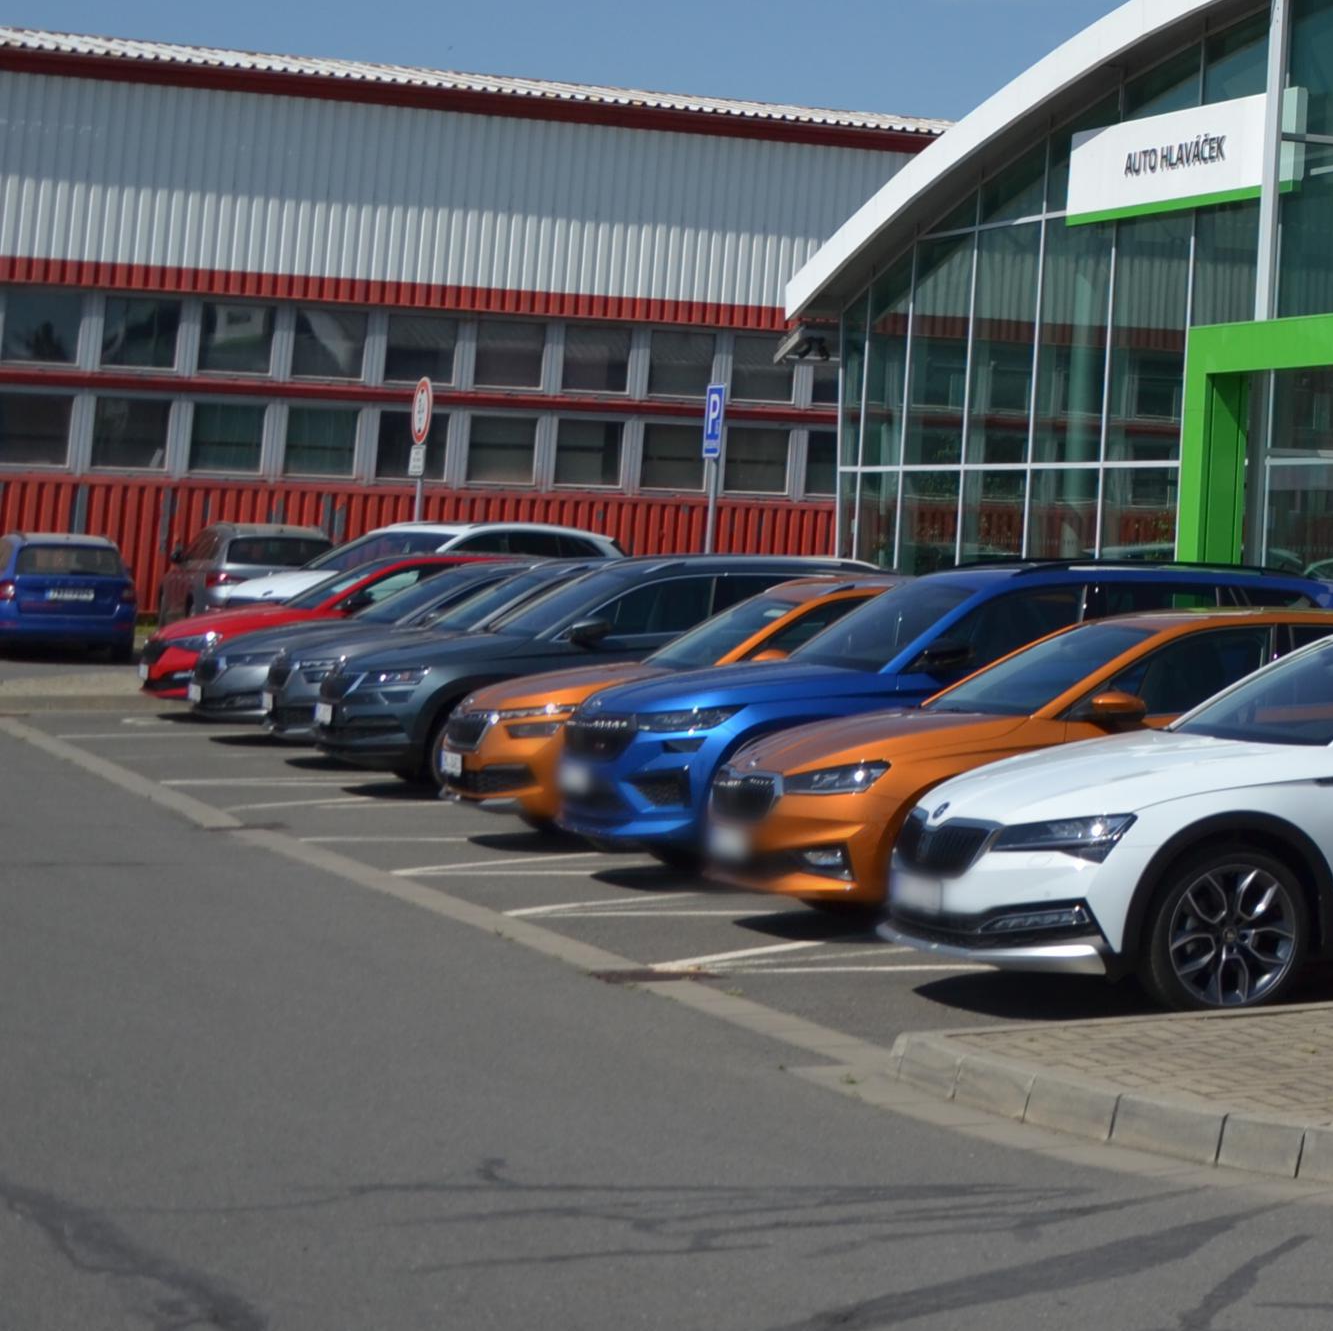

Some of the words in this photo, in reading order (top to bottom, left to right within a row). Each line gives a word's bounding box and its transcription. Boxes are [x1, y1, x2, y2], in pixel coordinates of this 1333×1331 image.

[1124, 148, 1158, 177] AUTO
[1160, 132, 1226, 171] HLAVÁČEK
[707, 393, 721, 435] P
